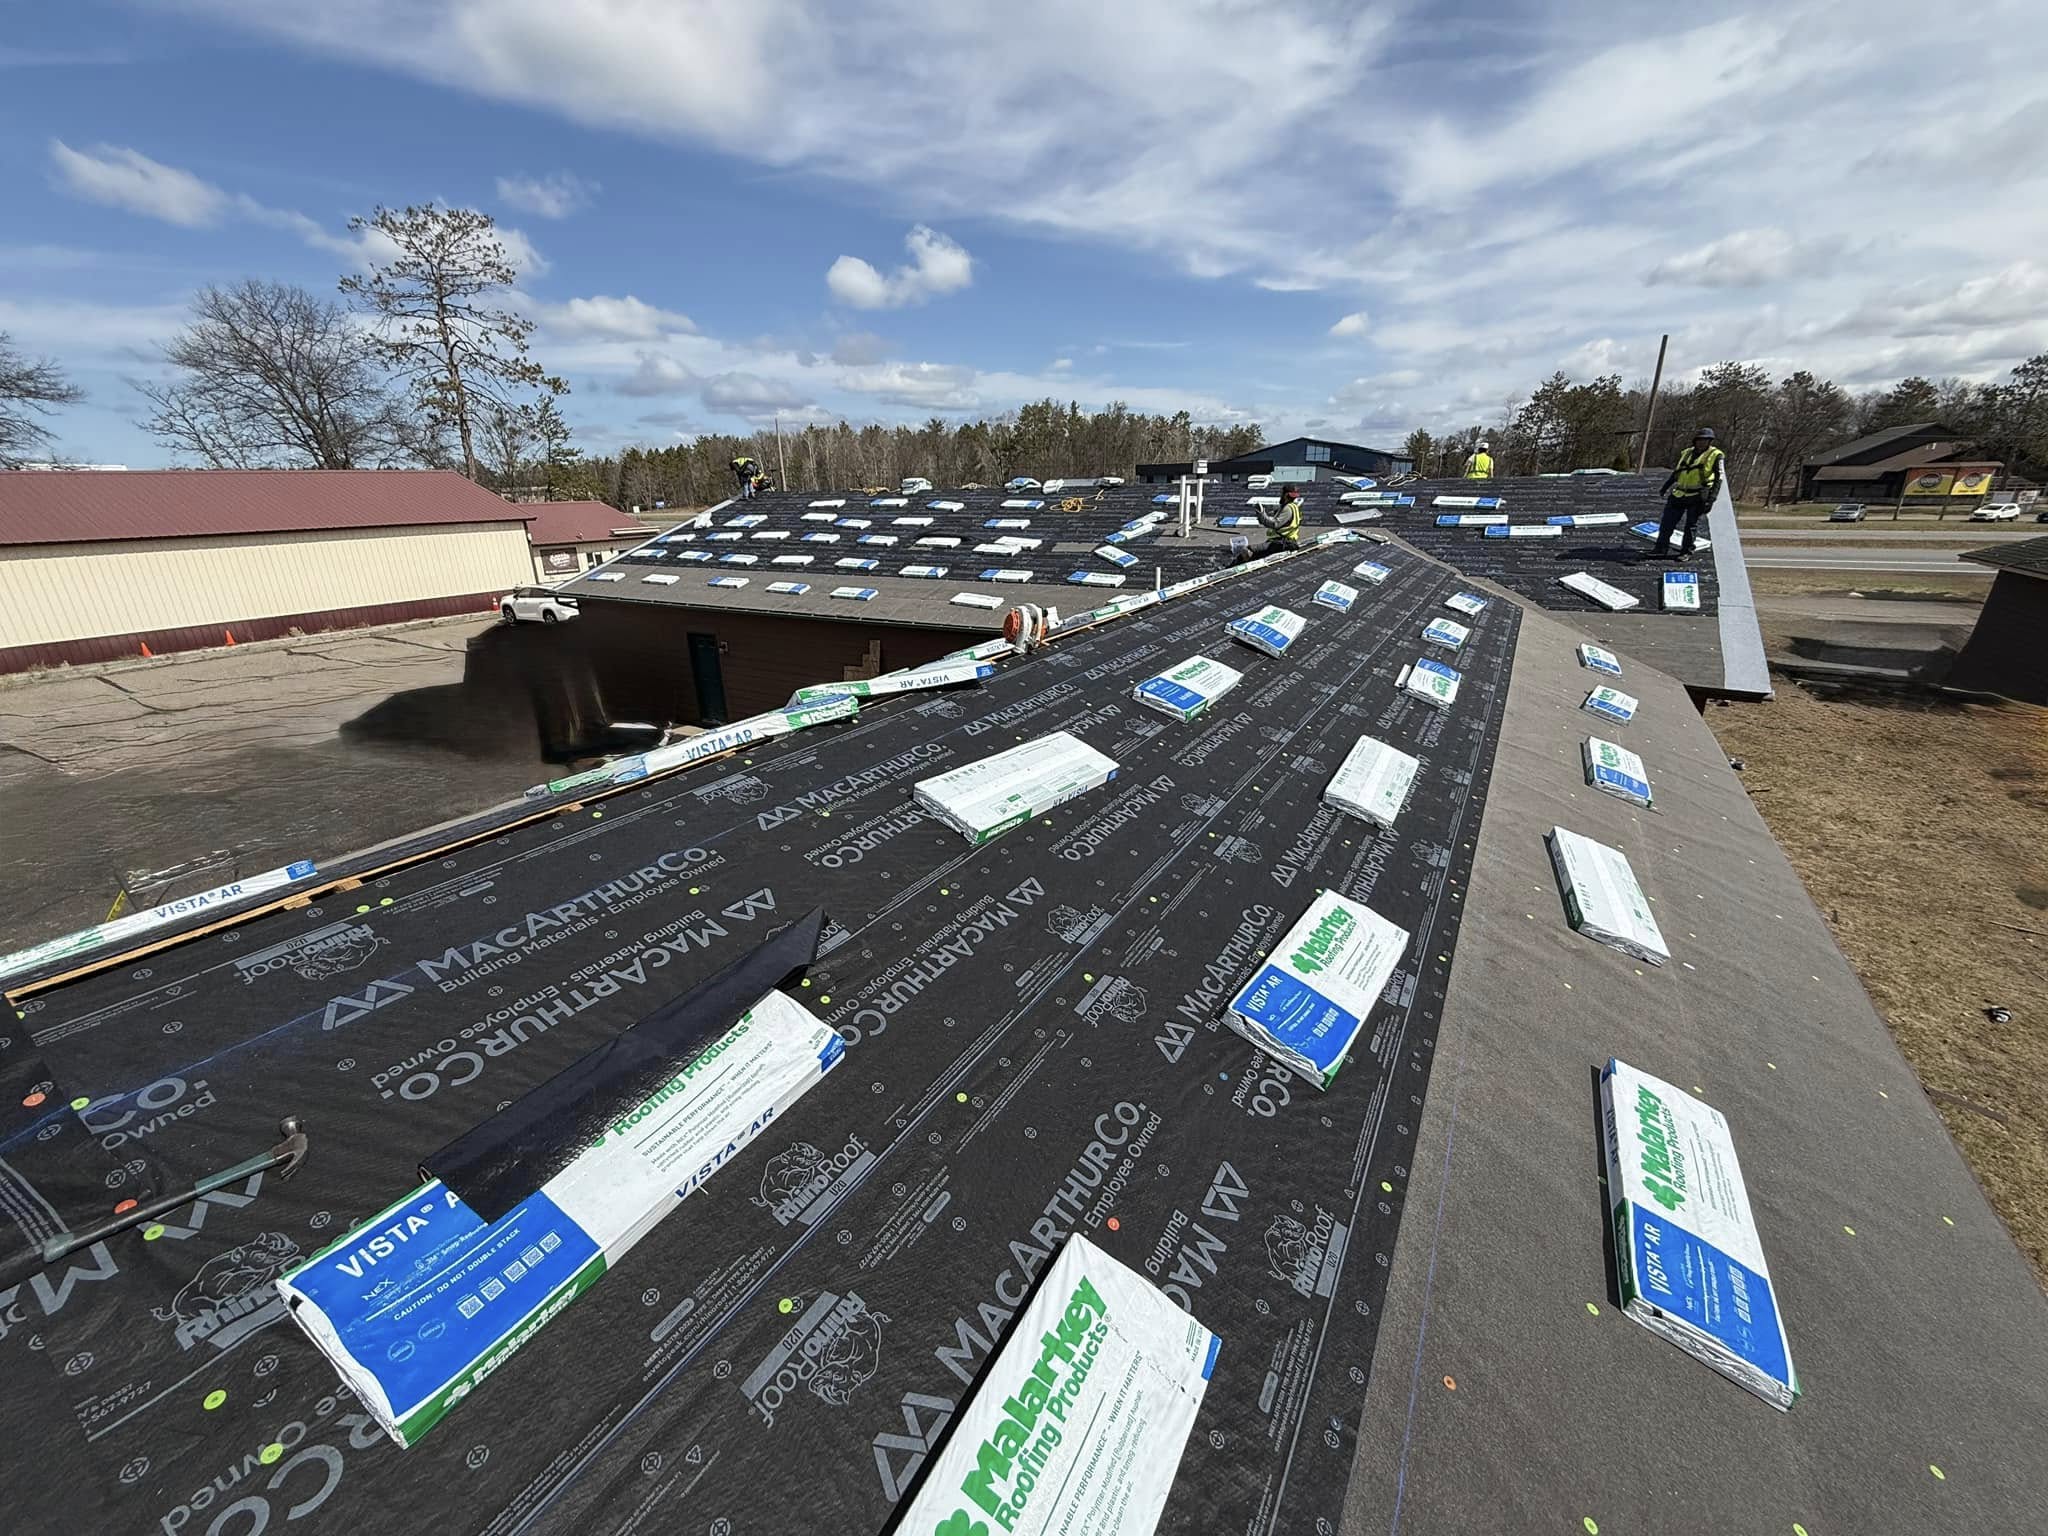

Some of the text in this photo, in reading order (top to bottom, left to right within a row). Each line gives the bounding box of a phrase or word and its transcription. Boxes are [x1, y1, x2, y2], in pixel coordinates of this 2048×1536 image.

[221, 884, 244, 899] AR
[438, 854, 727, 995] Building Materials Employee Owned
[857, 893, 995, 1000] Building Materials Employee
[1267, 910, 1286, 935] Owned
[1298, 905, 1354, 961] Malarkey
[370, 908, 707, 1090] Building Materials Employee Owned
[1268, 974, 1284, 989] AR
[1230, 1067, 1259, 1109] Owned
[101, 1090, 217, 1150] Owned
[749, 1106, 775, 1135] AR
[1634, 1083, 1673, 1185] Malarkey
[829, 1179, 848, 1198] U20
[1086, 1111, 1163, 1231] Employee Owned
[1145, 1208, 1189, 1277] Building
[1326, 1251, 1339, 1269] U20
[1643, 1221, 1661, 1246] AR
[361, 1277, 395, 1302] NEX
[392, 1227, 521, 1322] CAUTION: DO NOT DOUBLE STACK
[473, 1281, 580, 1383] Malarkey
[781, 1326, 804, 1351] U20
[960, 1274, 1108, 1518] Malarkey
[1108, 1398, 1123, 1424] WHEN
[993, 1422, 1064, 1532] Roofing
[1085, 1487, 1107, 1521] Polymer
[1099, 1457, 1119, 1489] Modified
[1097, 1511, 1111, 1528] and
[1113, 1469, 1127, 1484] and
[1109, 1504, 1127, 1530] clean
[1118, 1491, 1131, 1506] the
